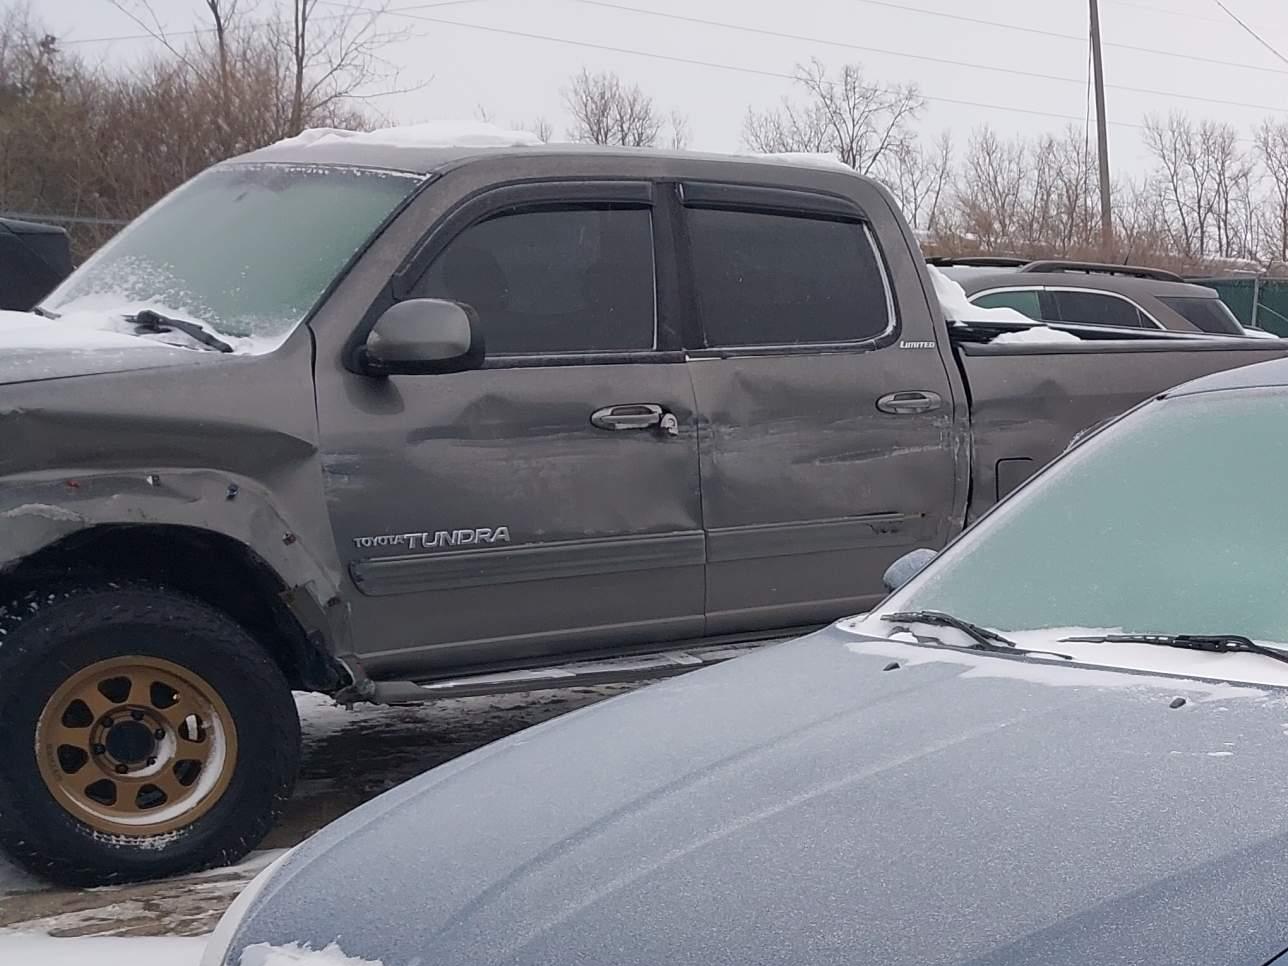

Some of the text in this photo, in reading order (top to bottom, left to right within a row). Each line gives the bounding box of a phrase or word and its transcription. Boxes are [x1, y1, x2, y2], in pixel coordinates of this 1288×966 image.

[900, 341, 936, 349] LIMITED
[353, 526, 512, 549] TOYOTA TUNDRA
